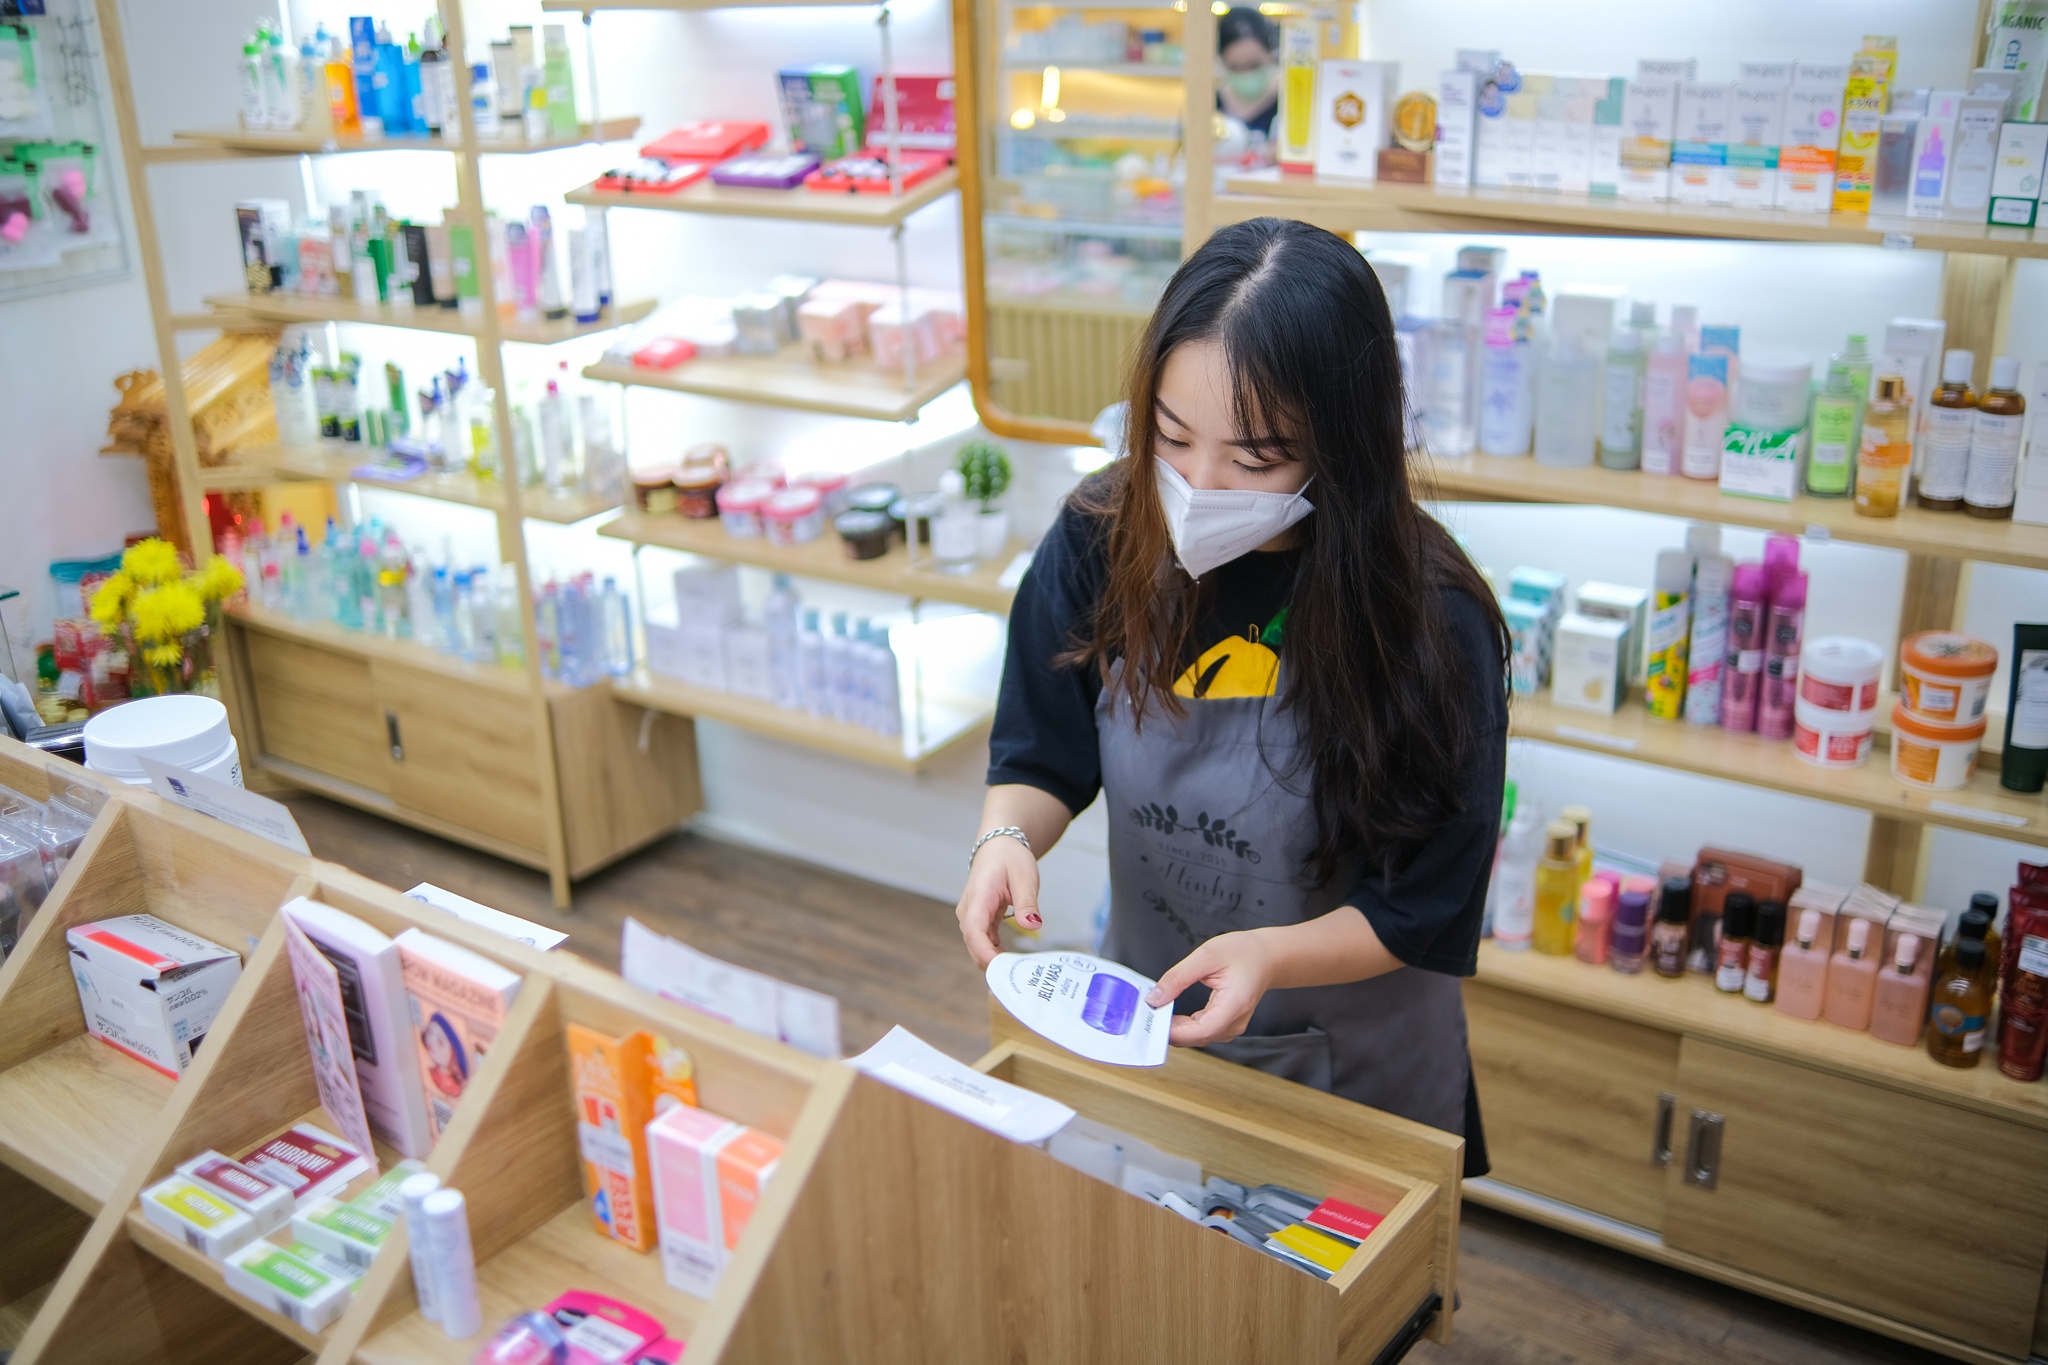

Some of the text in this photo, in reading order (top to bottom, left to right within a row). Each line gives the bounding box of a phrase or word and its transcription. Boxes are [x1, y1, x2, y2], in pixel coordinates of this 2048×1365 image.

[1200, 853, 1227, 868] 2015
[1027, 977, 1040, 987] Vita
[1037, 979, 1055, 1002] JELLY
[265, 1140, 333, 1174] HURRAW!
[219, 1167, 270, 1195] HURRAW!
